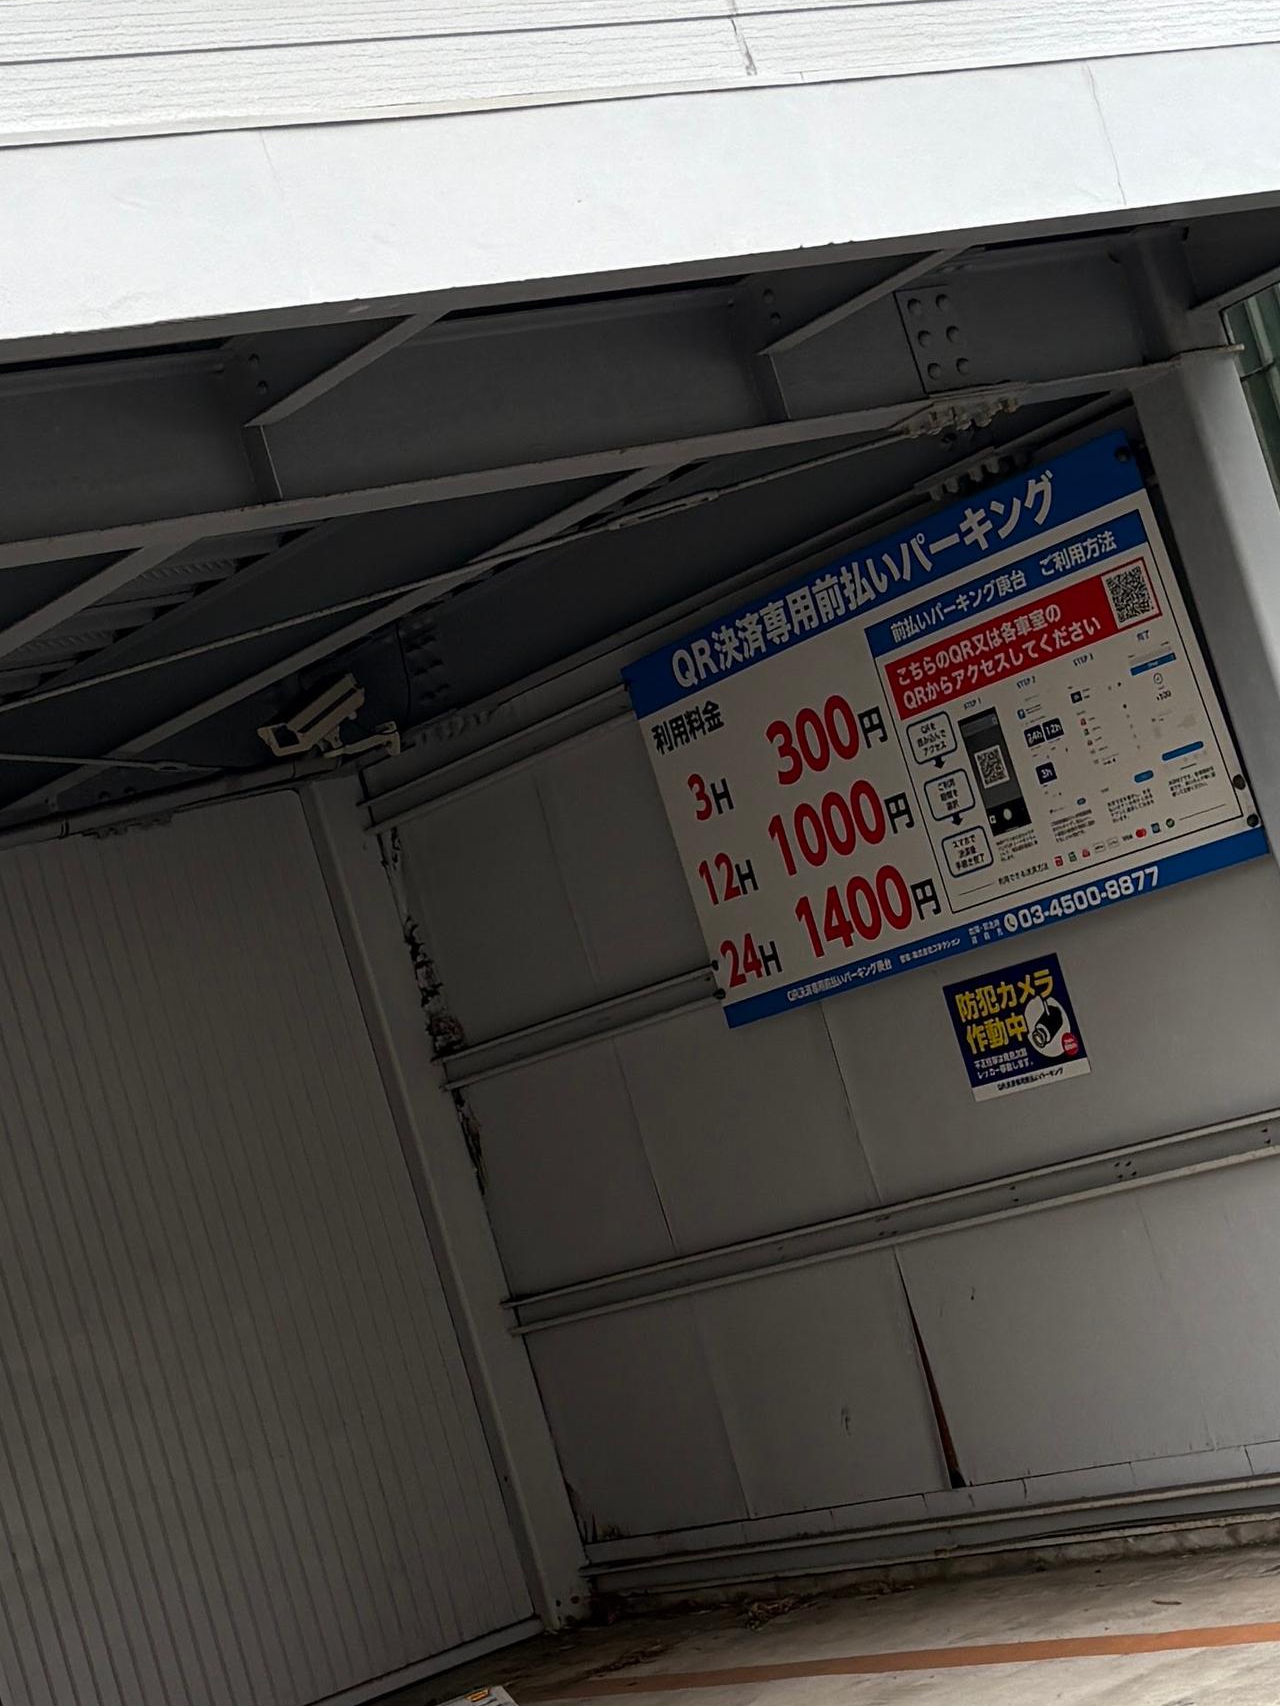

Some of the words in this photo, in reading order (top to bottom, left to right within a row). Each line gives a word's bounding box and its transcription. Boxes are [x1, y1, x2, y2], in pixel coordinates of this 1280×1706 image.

[673, 473, 1051, 685] QR決済専用前払いパーキング
[890, 570, 1026, 642] 前払いパーキング庚台
[1039, 530, 1116, 575] ご利用方法
[897, 604, 1060, 684] こちらのQR又は各車室の
[903, 617, 1100, 708] QRからアクセスしてください
[651, 701, 723, 753] 利用料金
[687, 774, 733, 820] 3H
[767, 696, 886, 784] 300円
[699, 853, 757, 904] 12H
[769, 781, 913, 874] 1000円
[720, 933, 781, 987] 24H
[796, 866, 939, 955] 1400円
[1017, 866, 1157, 927] 03-4500-8877
[955, 969, 1052, 1021] 防犯カメラ
[966, 1012, 1030, 1053] 作動中
